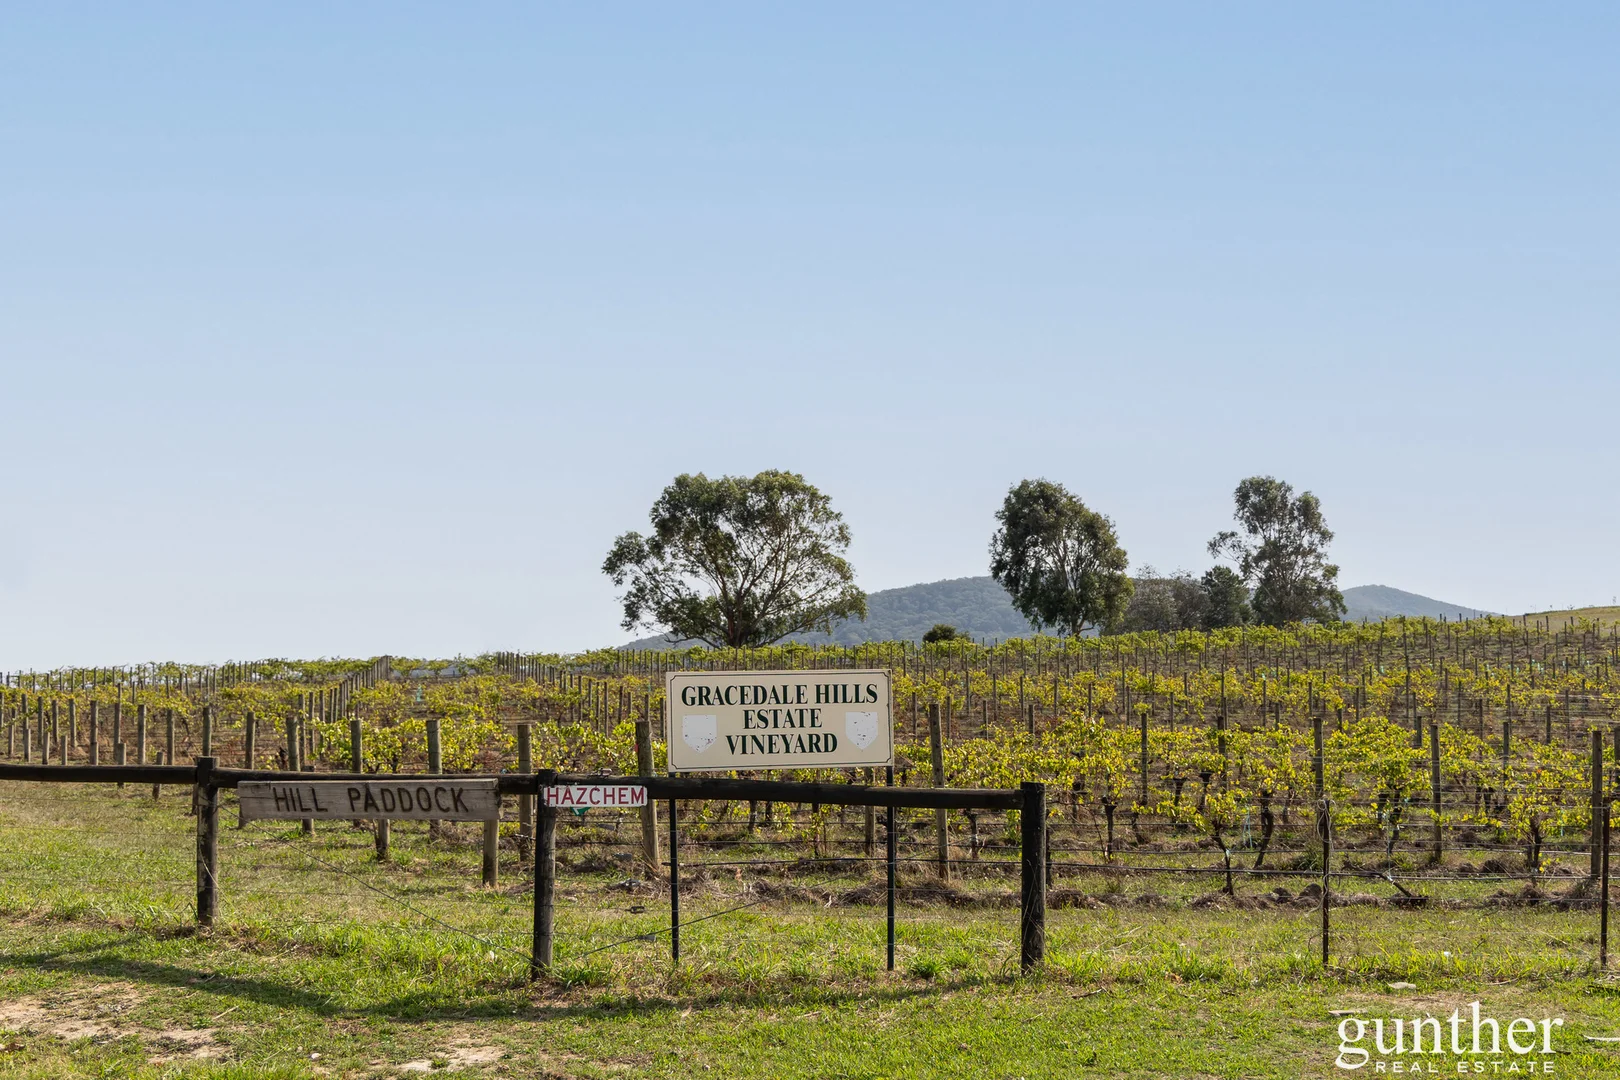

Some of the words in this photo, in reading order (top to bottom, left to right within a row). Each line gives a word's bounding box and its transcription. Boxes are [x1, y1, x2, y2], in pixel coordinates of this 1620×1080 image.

[681, 684, 808, 706] GRACEDALE
[815, 683, 878, 704] HILLS
[743, 708, 822, 729] ESTATE
[726, 733, 838, 755] VINEYARD
[272, 786, 328, 812] HILL
[347, 784, 469, 813] PADDOCK
[547, 786, 645, 805] HAZCHEM
